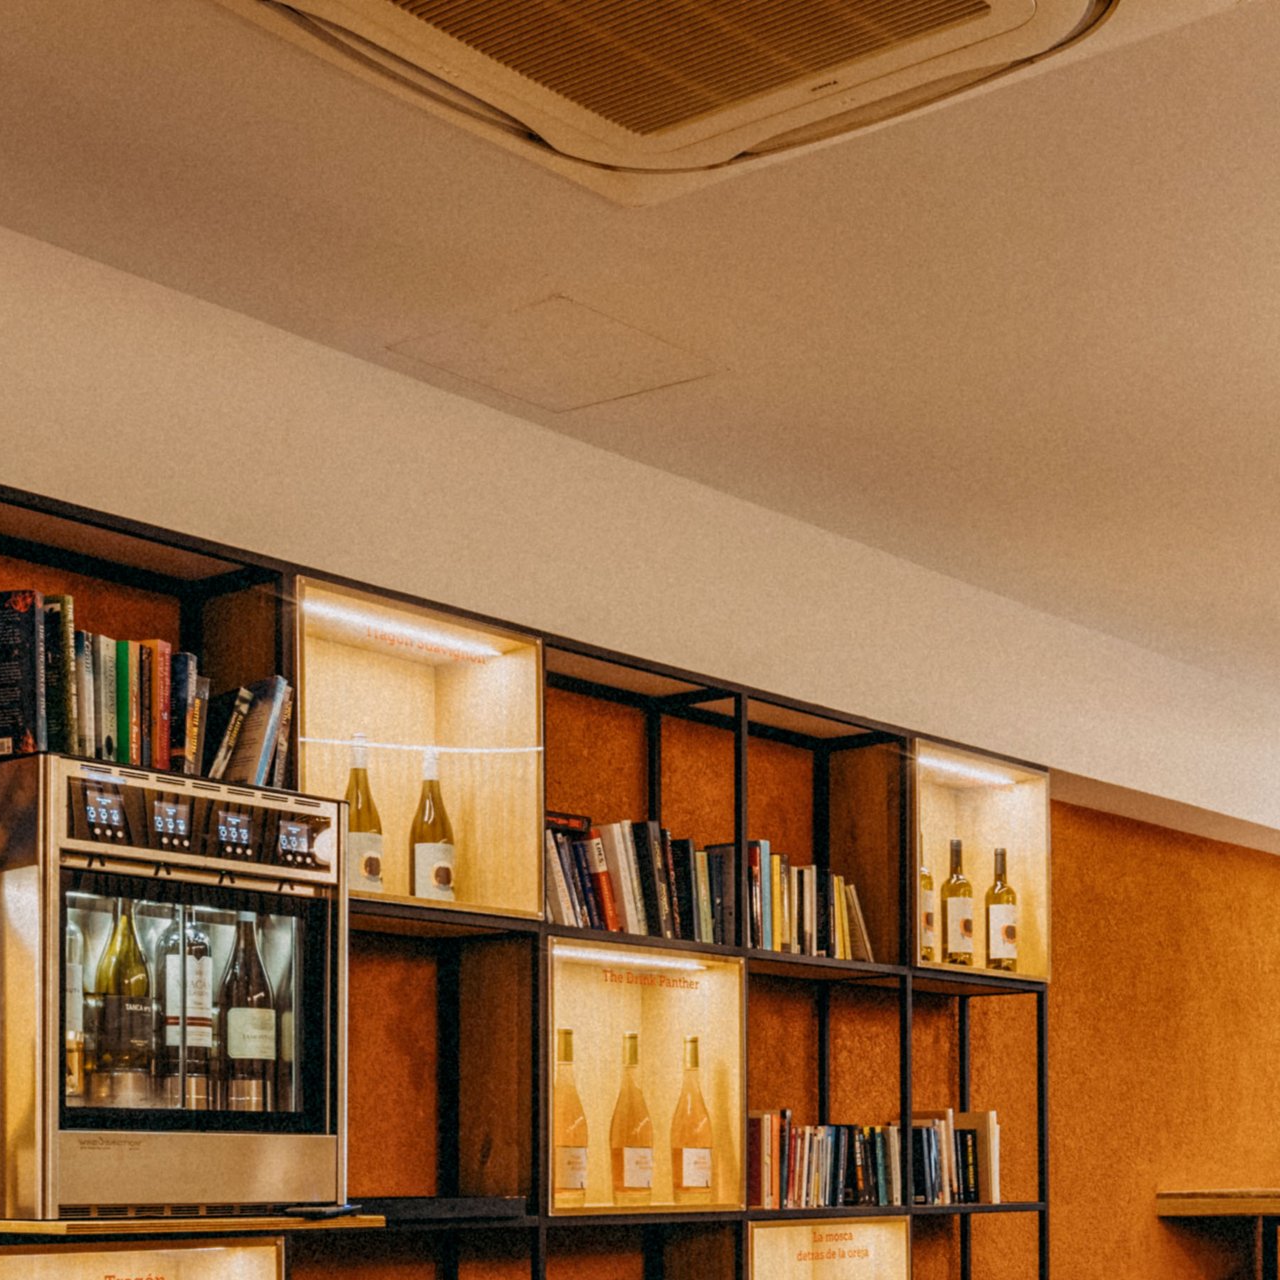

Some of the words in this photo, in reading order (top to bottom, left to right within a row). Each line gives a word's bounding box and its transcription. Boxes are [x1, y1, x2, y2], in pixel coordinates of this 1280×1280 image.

[603, 968, 624, 984] The
[626, 971, 657, 986] Drink
[659, 975, 700, 990] Panther
[813, 1232, 824, 1243] La
[825, 1232, 853, 1242] mosca
[825, 1247, 836, 1260] de
